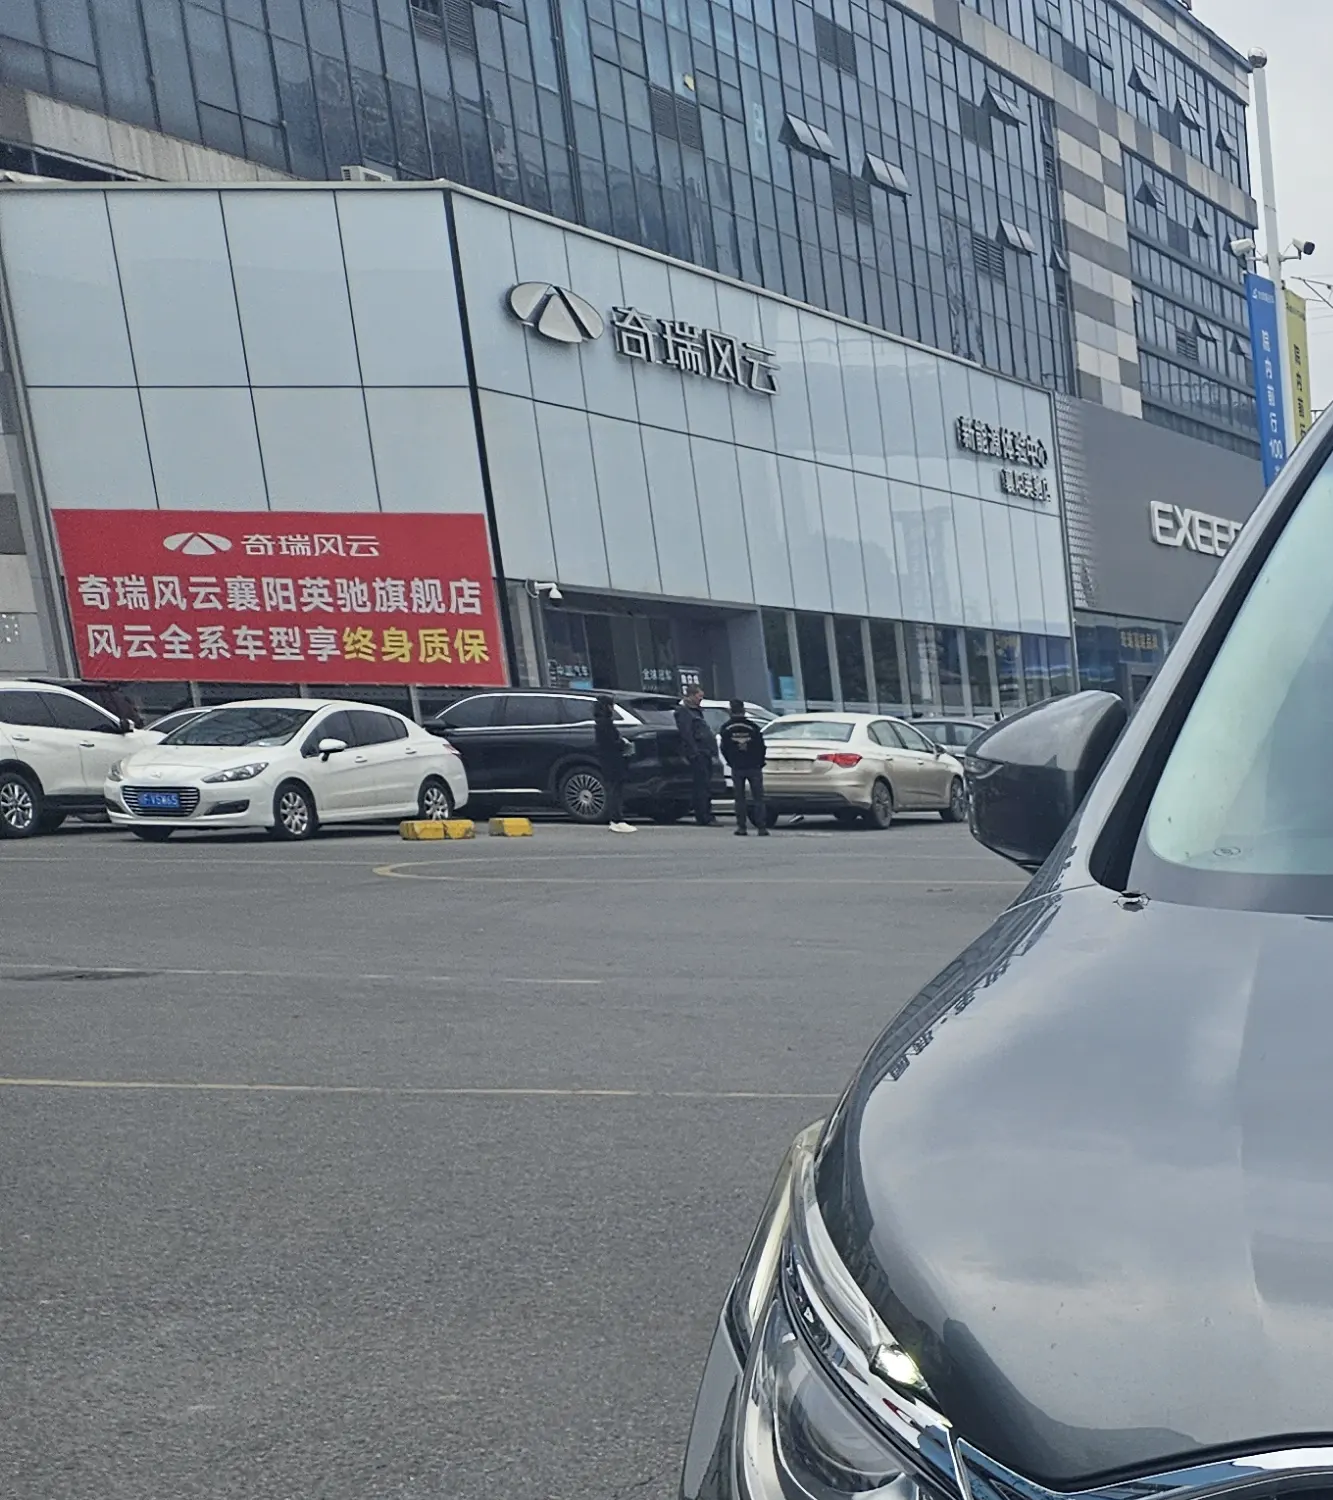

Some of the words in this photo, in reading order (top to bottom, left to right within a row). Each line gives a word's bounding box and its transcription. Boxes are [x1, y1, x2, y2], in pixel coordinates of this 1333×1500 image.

[611, 306, 780, 395] 奇瑞风云
[241, 533, 379, 556] 奇瑞风云
[78, 574, 482, 615] 奇瑞风云襄阳英驰旗舰店
[87, 624, 490, 664] 风云全系车型享终身质保
